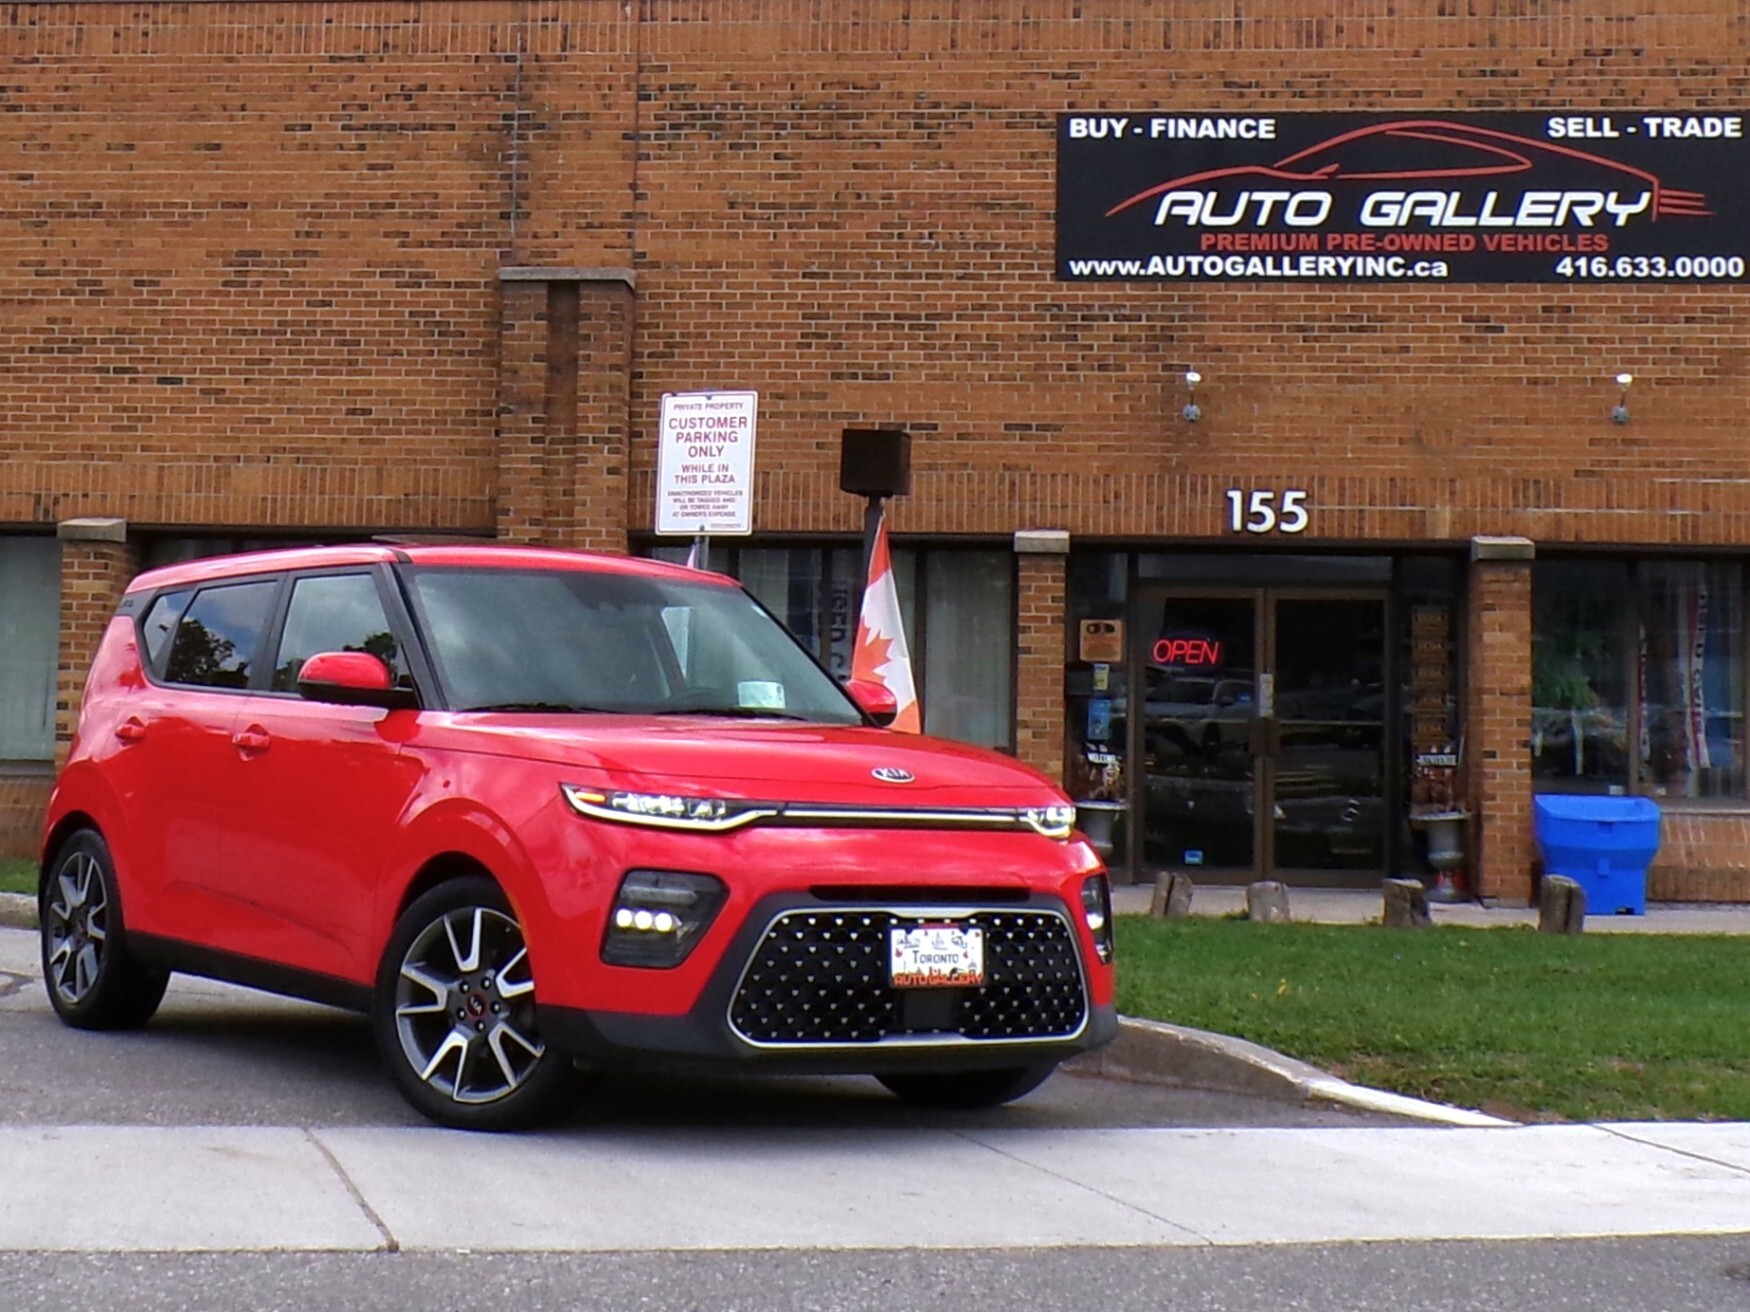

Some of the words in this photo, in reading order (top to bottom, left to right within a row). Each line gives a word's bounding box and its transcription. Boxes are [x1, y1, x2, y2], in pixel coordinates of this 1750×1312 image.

[1069, 118, 1128, 138] BUY
[1151, 119, 1276, 139] FINANCE
[1548, 117, 1619, 137] SELL
[1644, 117, 1742, 137] TRADE
[1154, 191, 1333, 226] AUTO
[1360, 191, 1652, 226] GALLERY
[1201, 234, 1318, 250] PREMIUM
[1327, 234, 1475, 251] PRE-OWNED
[1483, 234, 1609, 251] VEHICLES
[1069, 256, 1449, 277] www.AUTOGALLERYINC.ca
[1556, 257, 1744, 277] 416.633.0000
[705, 402, 744, 410] PROPERTY
[668, 416, 748, 430] CUSTOMER
[675, 431, 739, 444] PARKING
[688, 445, 724, 458] ONLY
[681, 464, 714, 473] WHILE
[718, 464, 729, 473] IN
[674, 475, 697, 484] THIS
[701, 475, 735, 484] PLAZA
[1227, 490, 1309, 532] 155
[1153, 639, 1219, 664] OPEN
